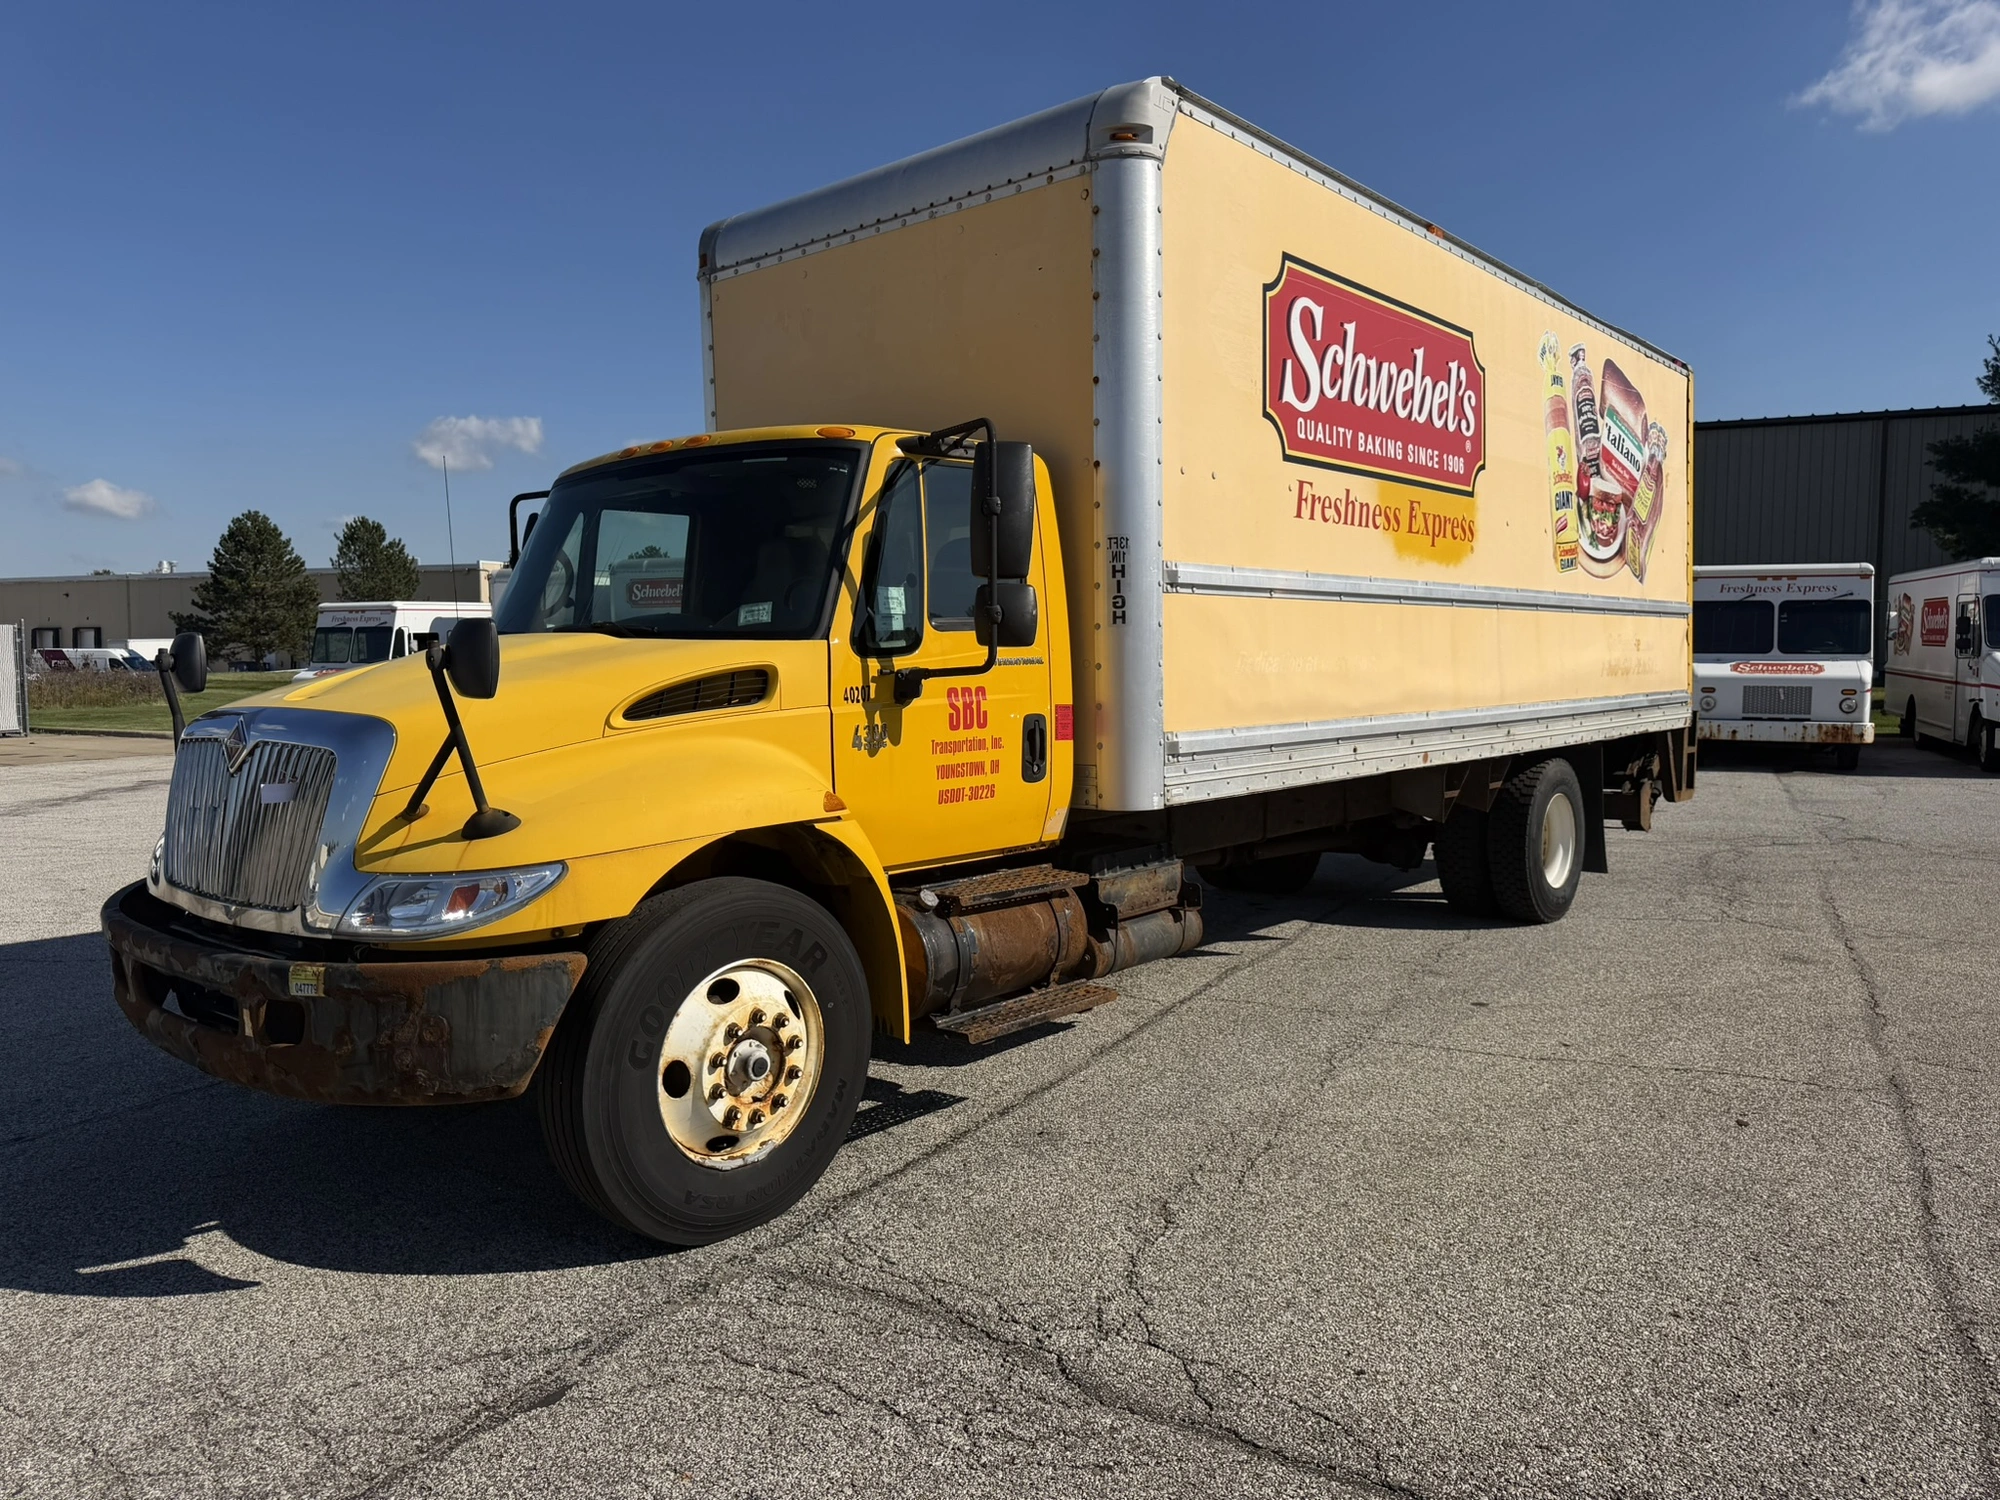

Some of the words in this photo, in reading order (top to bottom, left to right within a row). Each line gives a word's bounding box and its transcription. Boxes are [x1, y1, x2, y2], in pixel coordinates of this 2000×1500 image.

[1280, 296, 1477, 437] Schwebel's
[1296, 417, 1354, 450] QUALITY
[1358, 434, 1403, 461] BAKING
[1407, 443, 1440, 469] SINCE
[1443, 453, 1465, 475] 1906
[1555, 490, 1574, 511] GIANT
[1293, 479, 1402, 533] Freshness
[1406, 499, 1475, 548] Express
[1559, 557, 1577, 570] GIANT
[1719, 582, 1782, 594] Freshness
[1786, 582, 1838, 595] Express
[331, 614, 359, 623] Freshness
[359, 614, 382, 624] Express
[1736, 662, 1819, 673] Schwebel's
[843, 685, 871, 704] 40207
[946, 686, 988, 731] SBC
[931, 736, 989, 756] Transportation,
[990, 735, 1005, 750] Inc.
[936, 760, 988, 781] YOUNGSTOWN,
[989, 759, 1000, 774] OH
[938, 784, 996, 805] USDOT-30226
